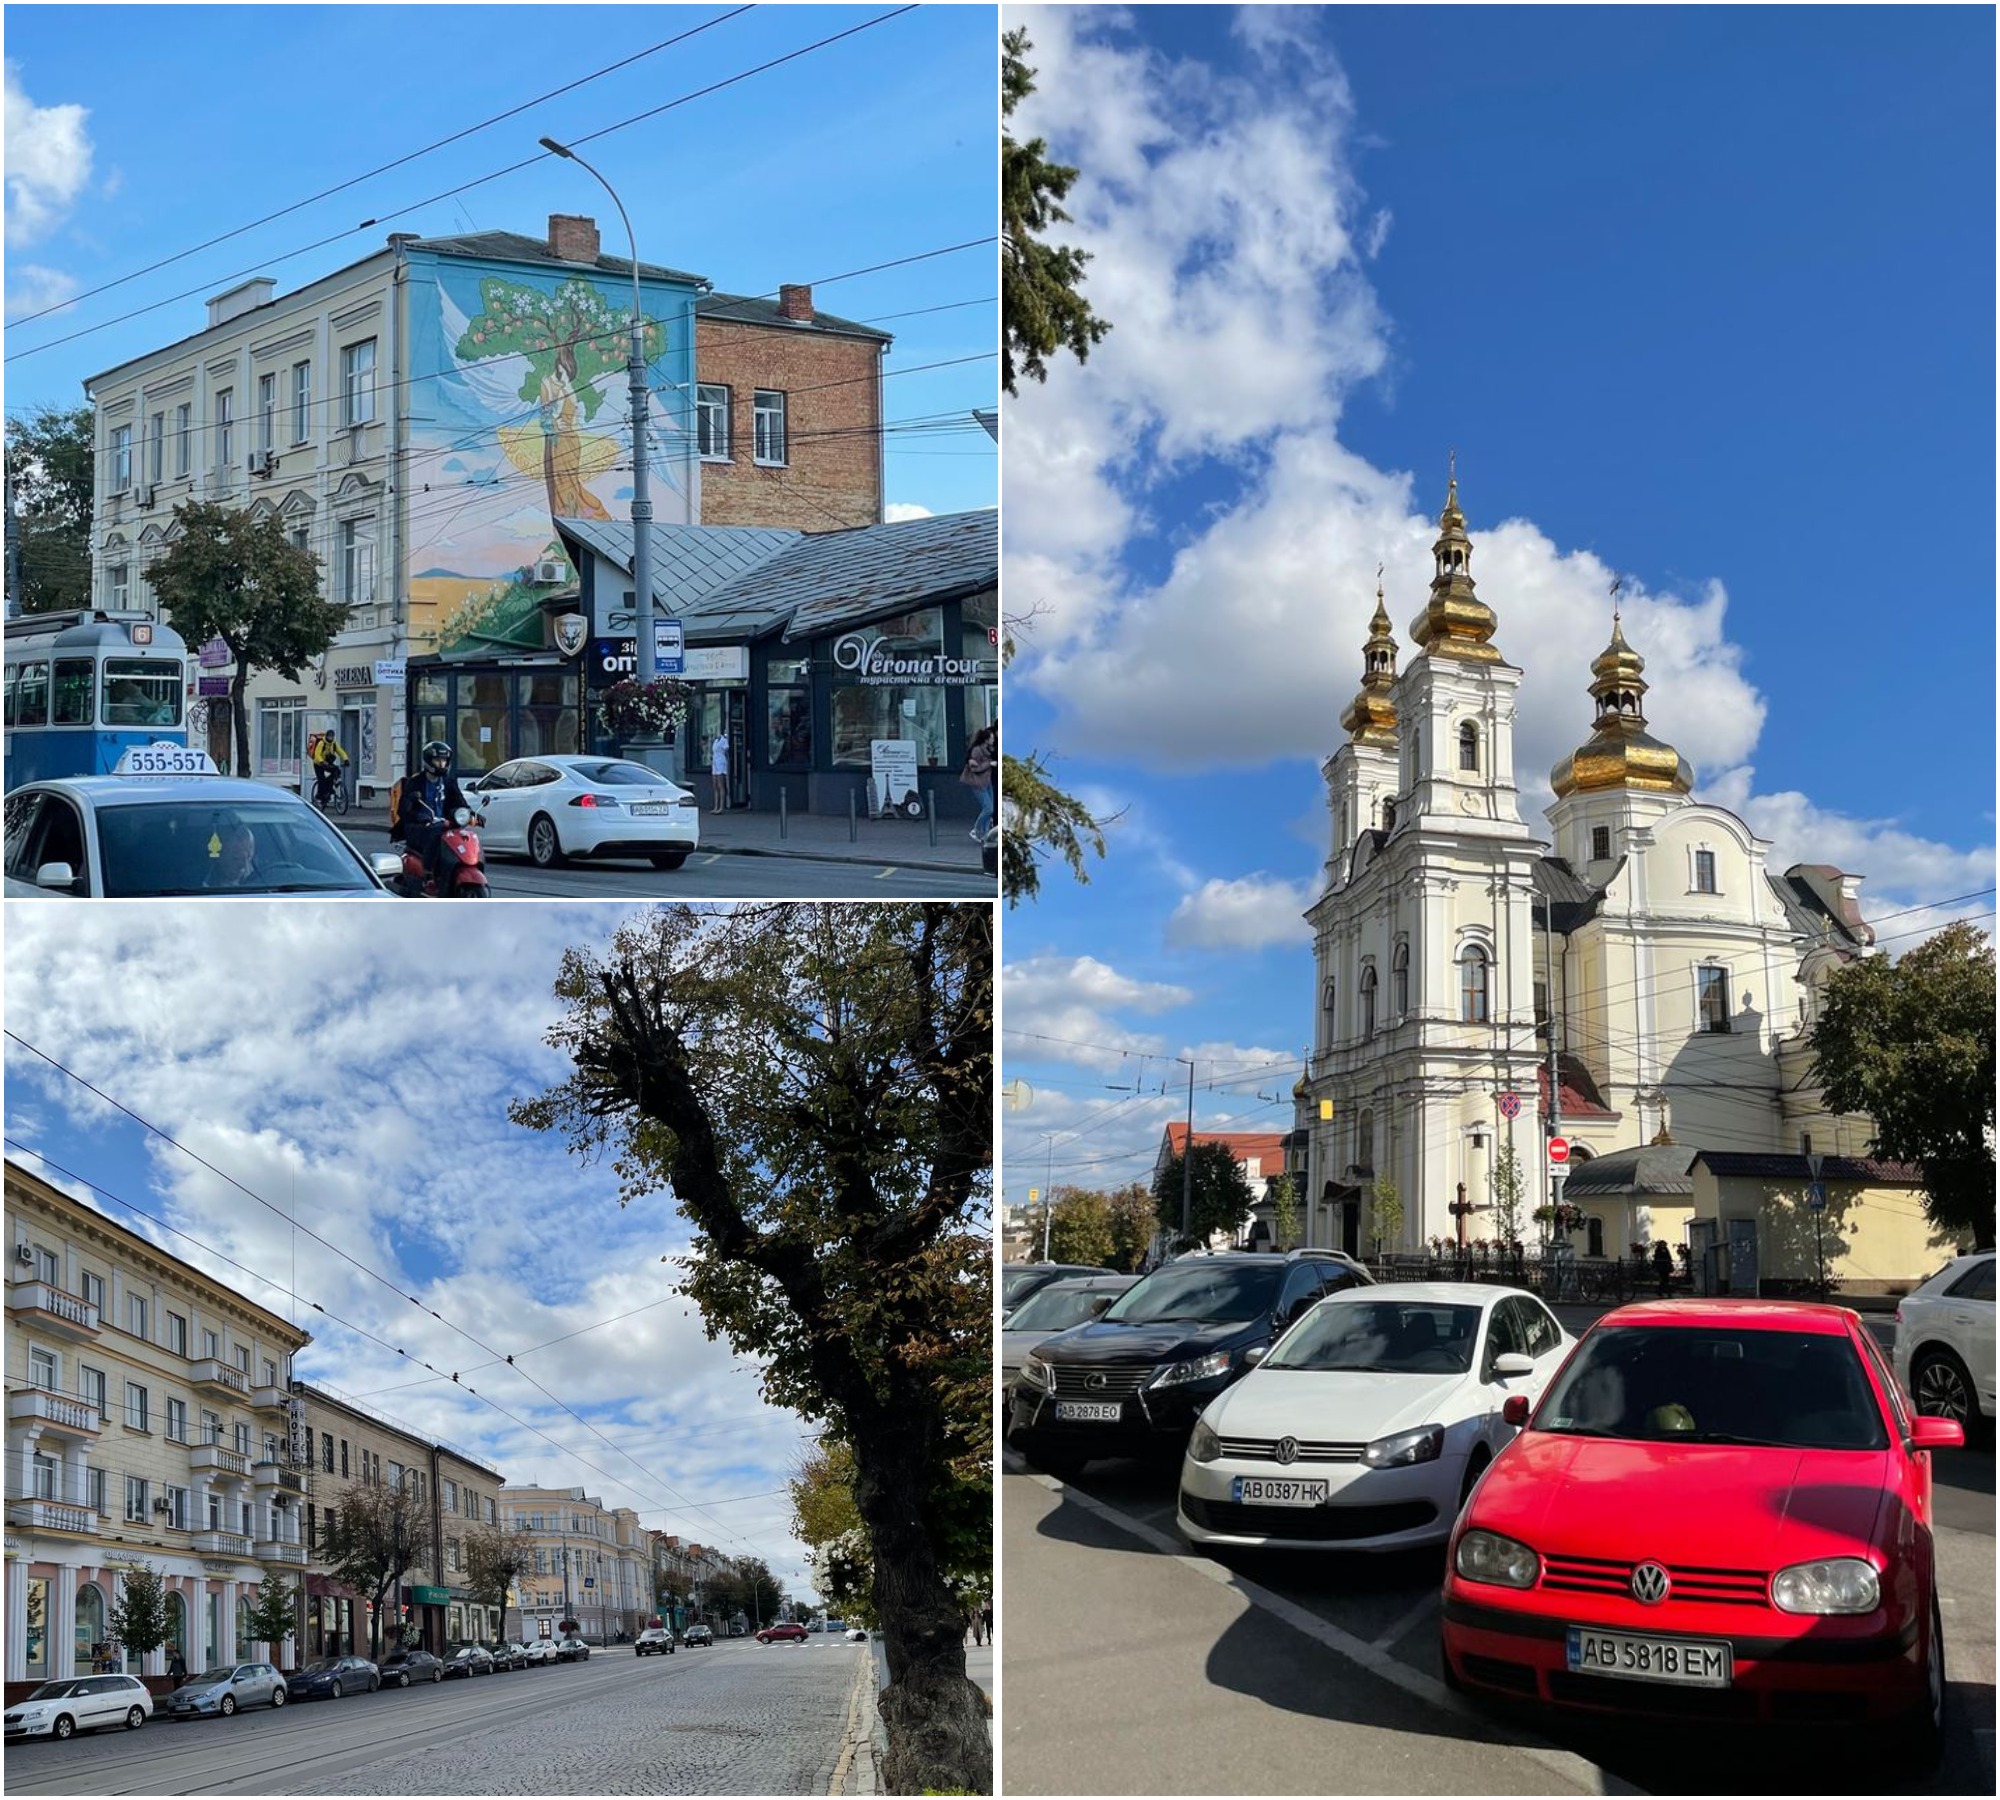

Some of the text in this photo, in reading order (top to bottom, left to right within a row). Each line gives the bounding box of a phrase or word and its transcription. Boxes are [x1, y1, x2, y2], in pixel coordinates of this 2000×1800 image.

[137, 628, 146, 639] 6
[131, 753, 206, 771] 555-557
[1062, 1405, 1117, 1418] AB 2878 EO
[290, 1410, 299, 1463] HOTEL
[1242, 1482, 1323, 1500] AB 0387 HK
[1583, 1637, 1723, 1678] AB 5818 EM
